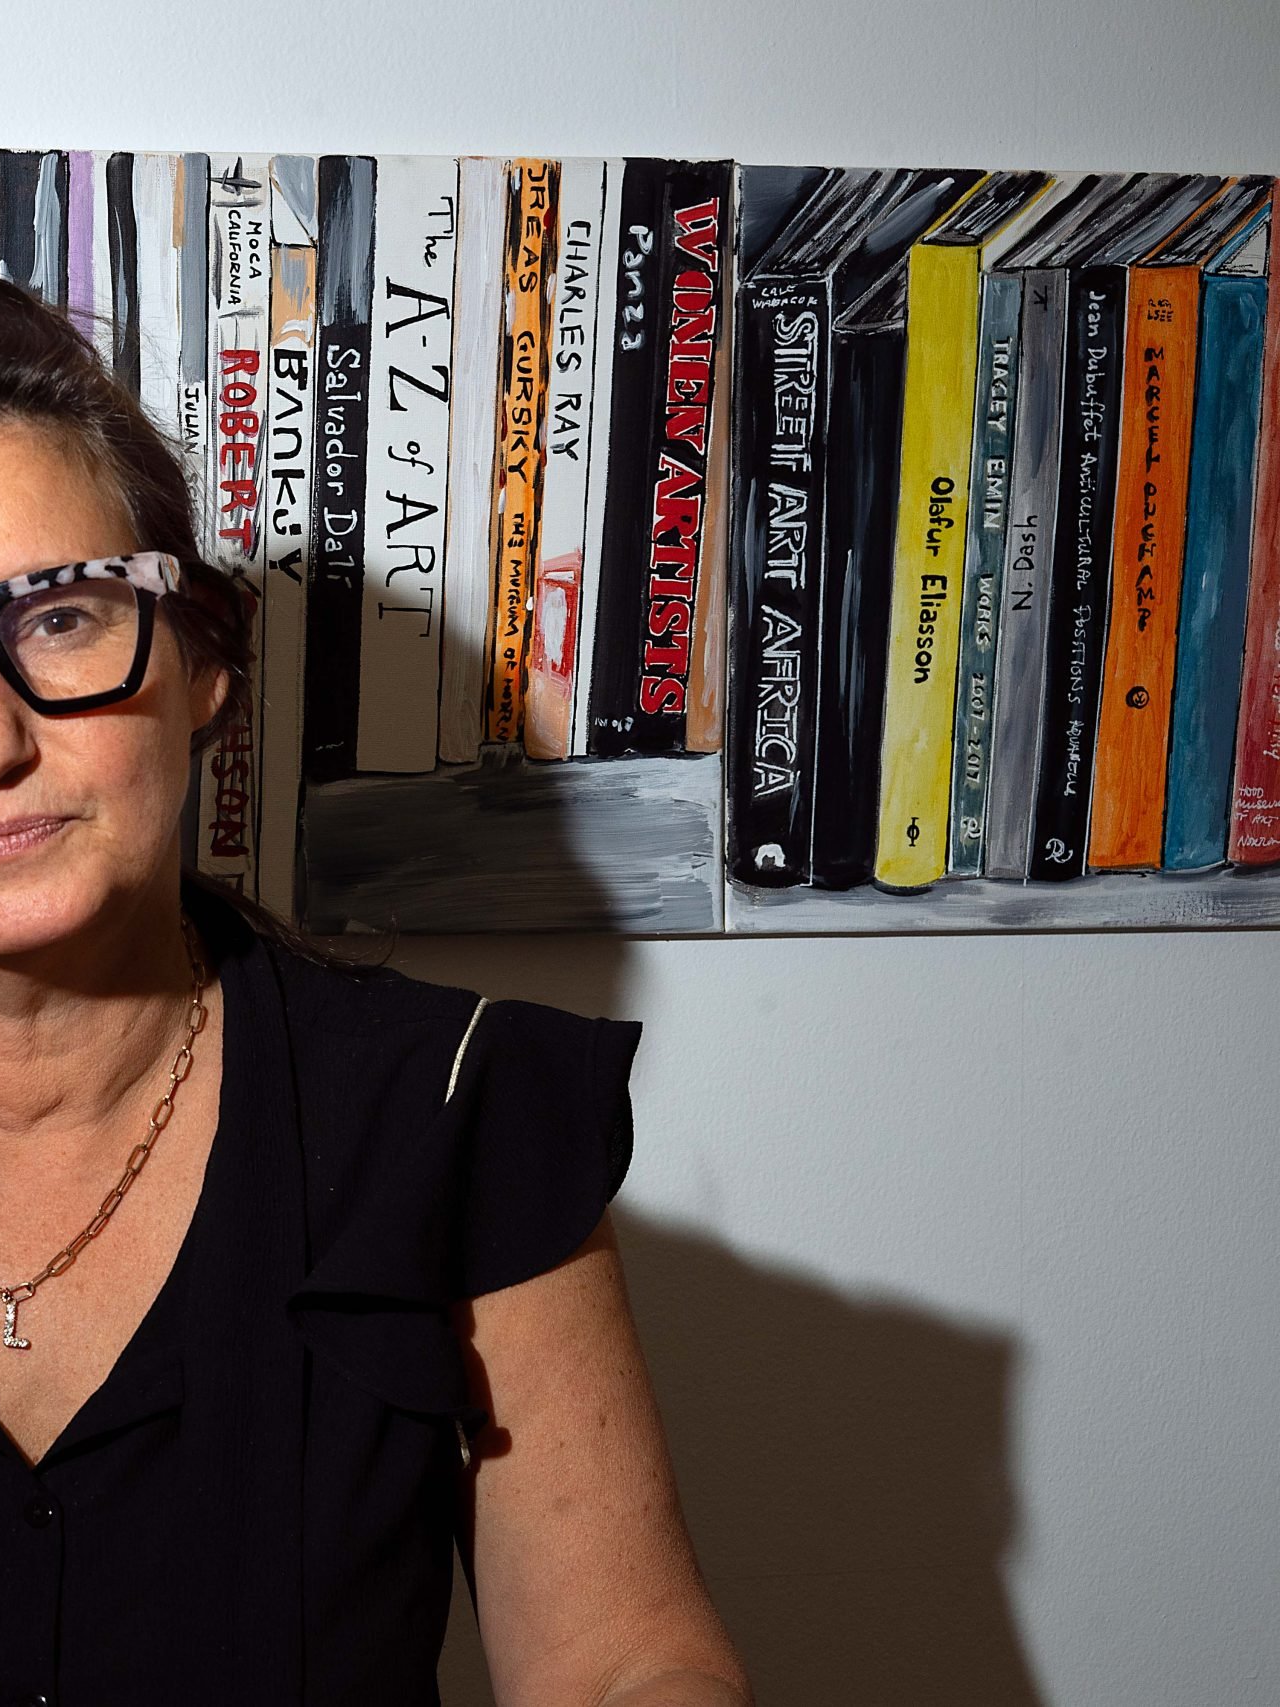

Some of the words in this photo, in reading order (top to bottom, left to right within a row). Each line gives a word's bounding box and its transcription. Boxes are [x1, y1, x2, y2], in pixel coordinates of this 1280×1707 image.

[228, 209, 242, 306] CALIFORNIA
[245, 220, 262, 280] MOCA
[424, 196, 455, 268] The
[555, 219, 592, 374] CHARLES
[620, 224, 654, 353] Panza
[663, 196, 721, 453] WOMEN
[1087, 289, 1107, 338] Jean
[385, 275, 451, 412] A-Z
[770, 311, 818, 473] STREET
[986, 336, 1014, 434] TRACEY
[1080, 346, 1108, 443] Dubuffet
[184, 387, 200, 455] JULIAN
[218, 349, 261, 557] ROBERT
[324, 344, 362, 497] Salvador
[387, 440, 435, 475] of
[508, 330, 536, 483] GURSKY
[551, 393, 582, 460] RAY
[764, 482, 809, 590] ART
[921, 475, 956, 558] Olafur
[982, 455, 1007, 529] EMIN
[1012, 514, 1039, 572] Dash
[377, 489, 439, 638] ART
[639, 452, 706, 715] ARTISTS
[975, 572, 994, 647] WORKS
[913, 573, 949, 685] Eliasson
[752, 603, 803, 798] AFRICA
